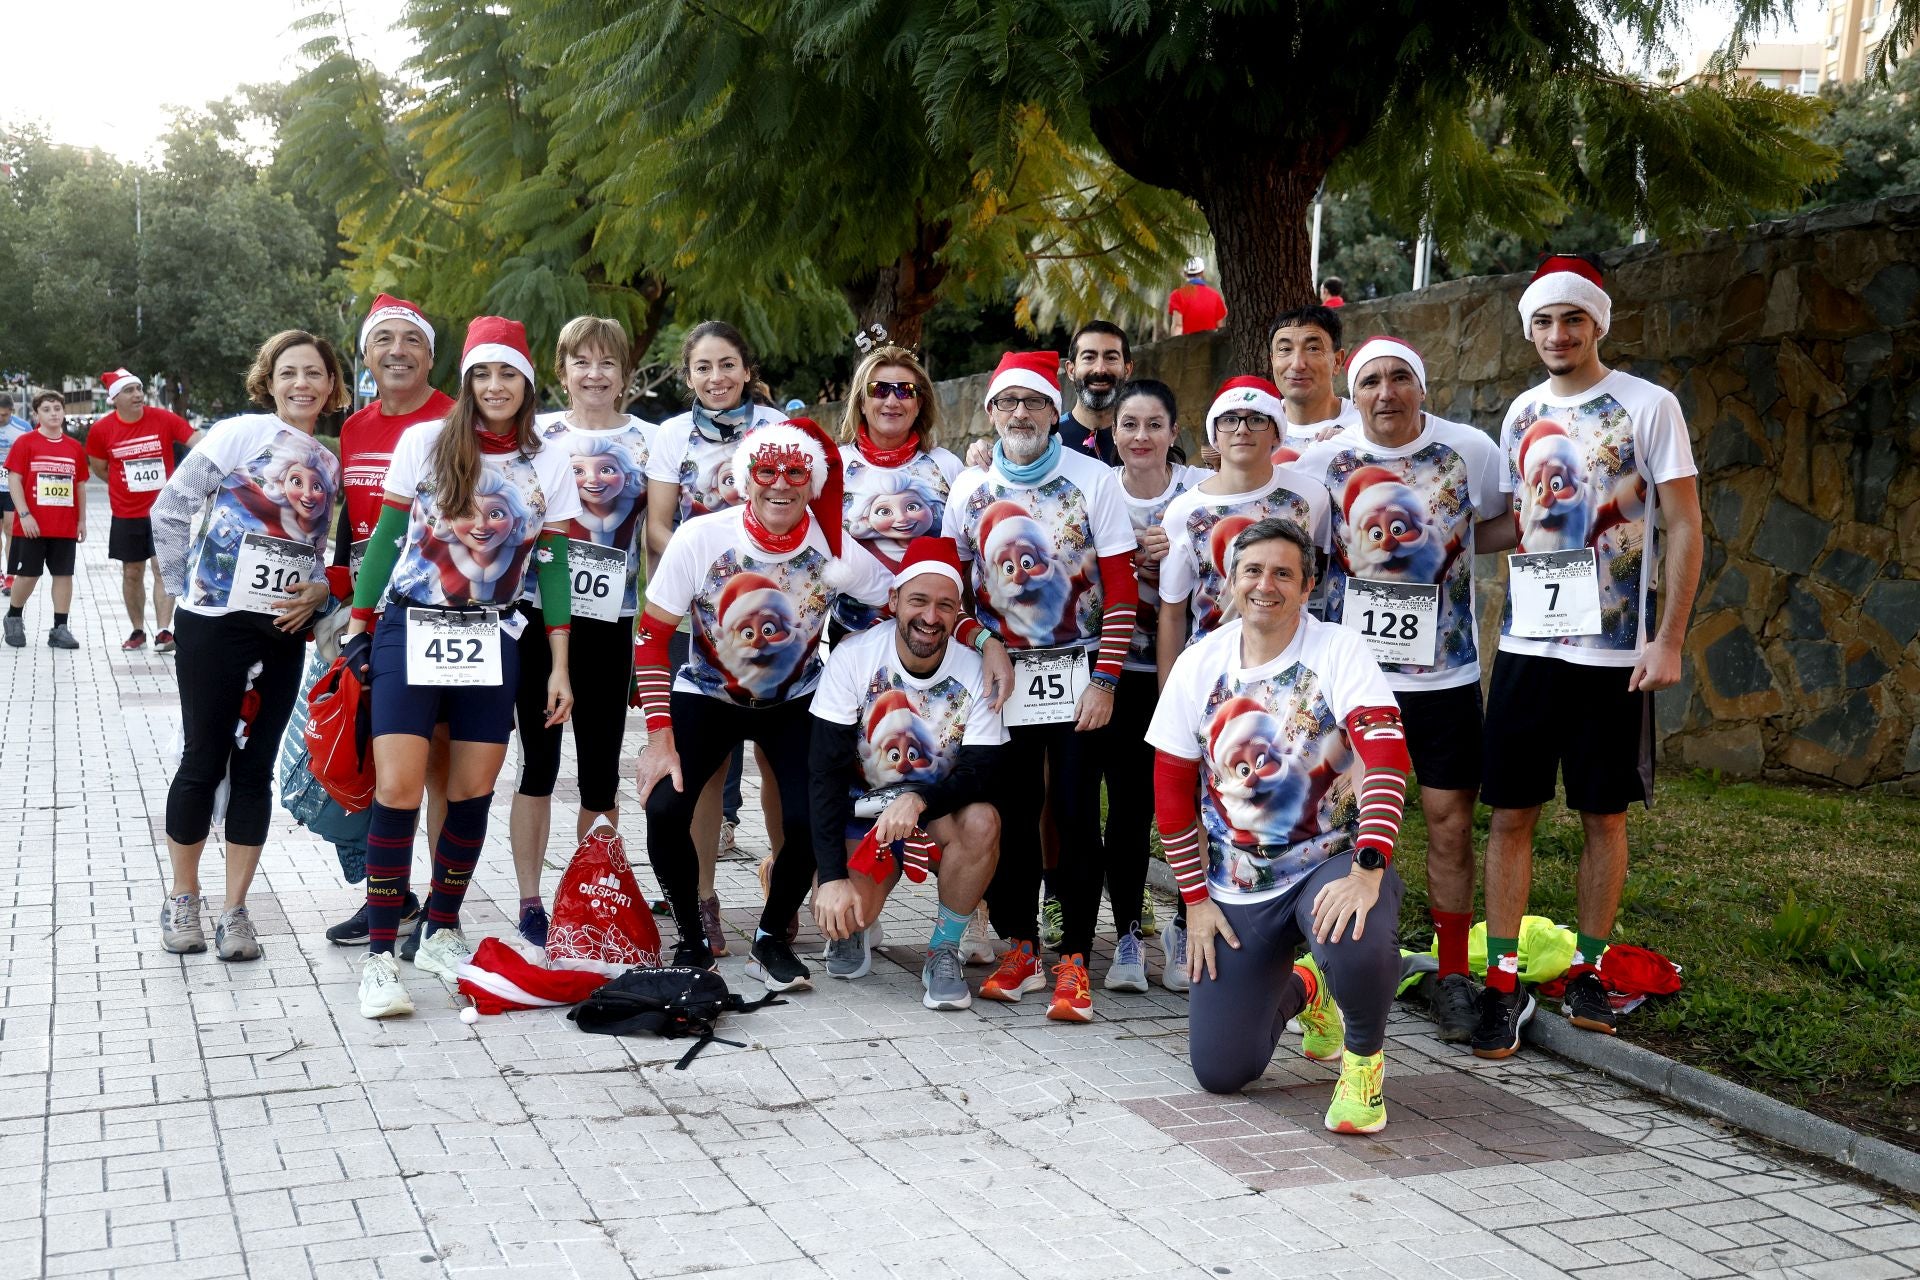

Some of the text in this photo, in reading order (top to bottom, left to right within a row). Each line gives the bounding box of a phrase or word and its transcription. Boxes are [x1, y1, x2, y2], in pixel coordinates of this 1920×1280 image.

[759, 442, 800, 454] FELIZ
[134, 470, 159, 482] 440
[350, 478, 378, 486] PALMA
[44, 486, 69, 496] 1022
[252, 564, 300, 594] 310
[570, 568, 610, 598] 06
[1545, 583, 1560, 610] 7
[1361, 610, 1418, 640] 128
[425, 638, 484, 663] 452
[1029, 674, 1064, 700] 45
[368, 886, 398, 896] BARÇA
